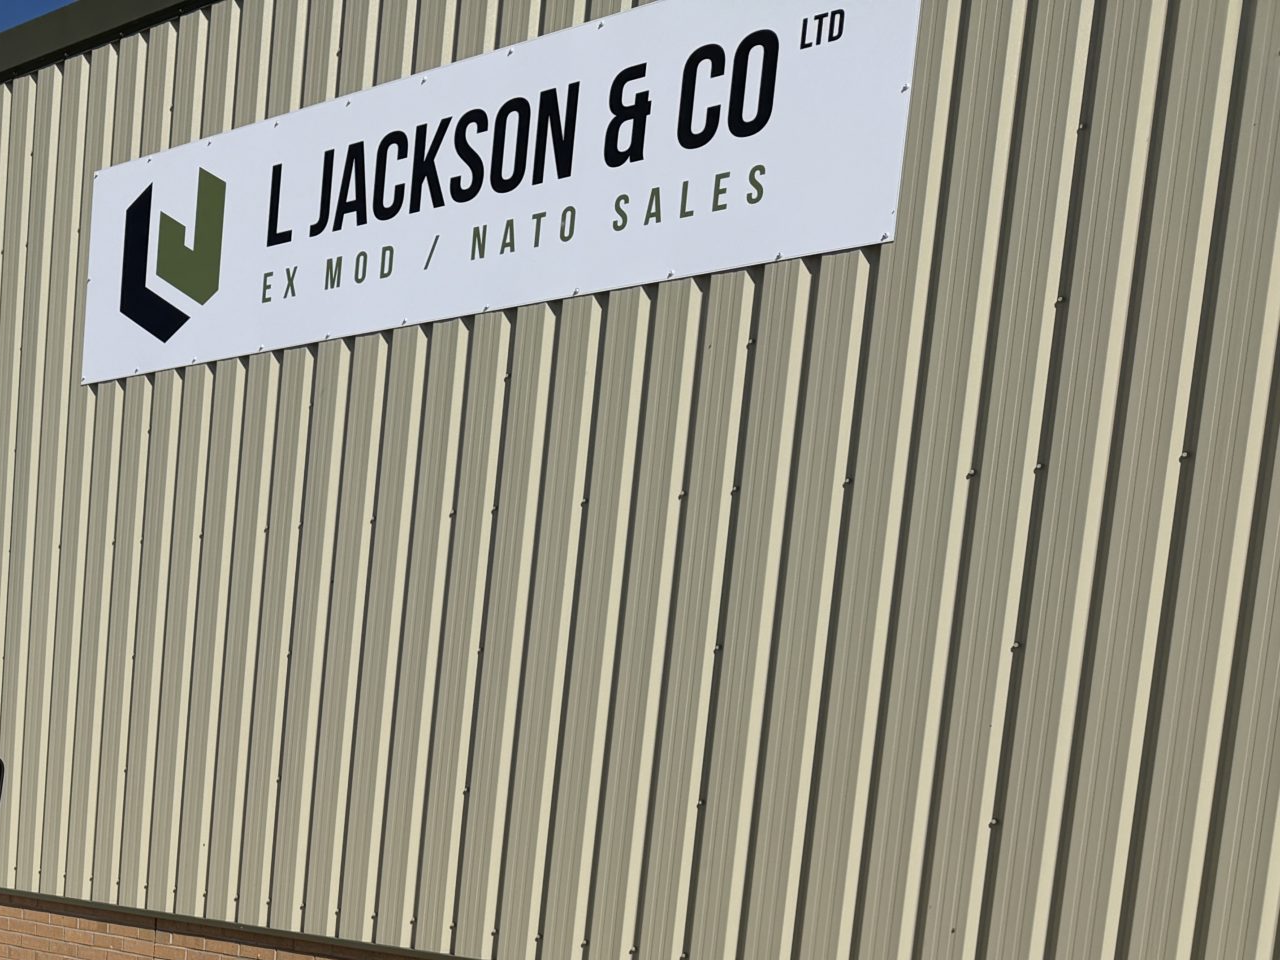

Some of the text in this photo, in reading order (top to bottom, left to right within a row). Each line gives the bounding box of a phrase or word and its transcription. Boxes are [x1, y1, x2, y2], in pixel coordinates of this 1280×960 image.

[266, 8, 845, 248] L JACKSON & CO LTD
[261, 265, 299, 304] EX
[324, 245, 394, 291] MOD
[470, 205, 577, 261] NATO
[612, 164, 767, 232] SALES
